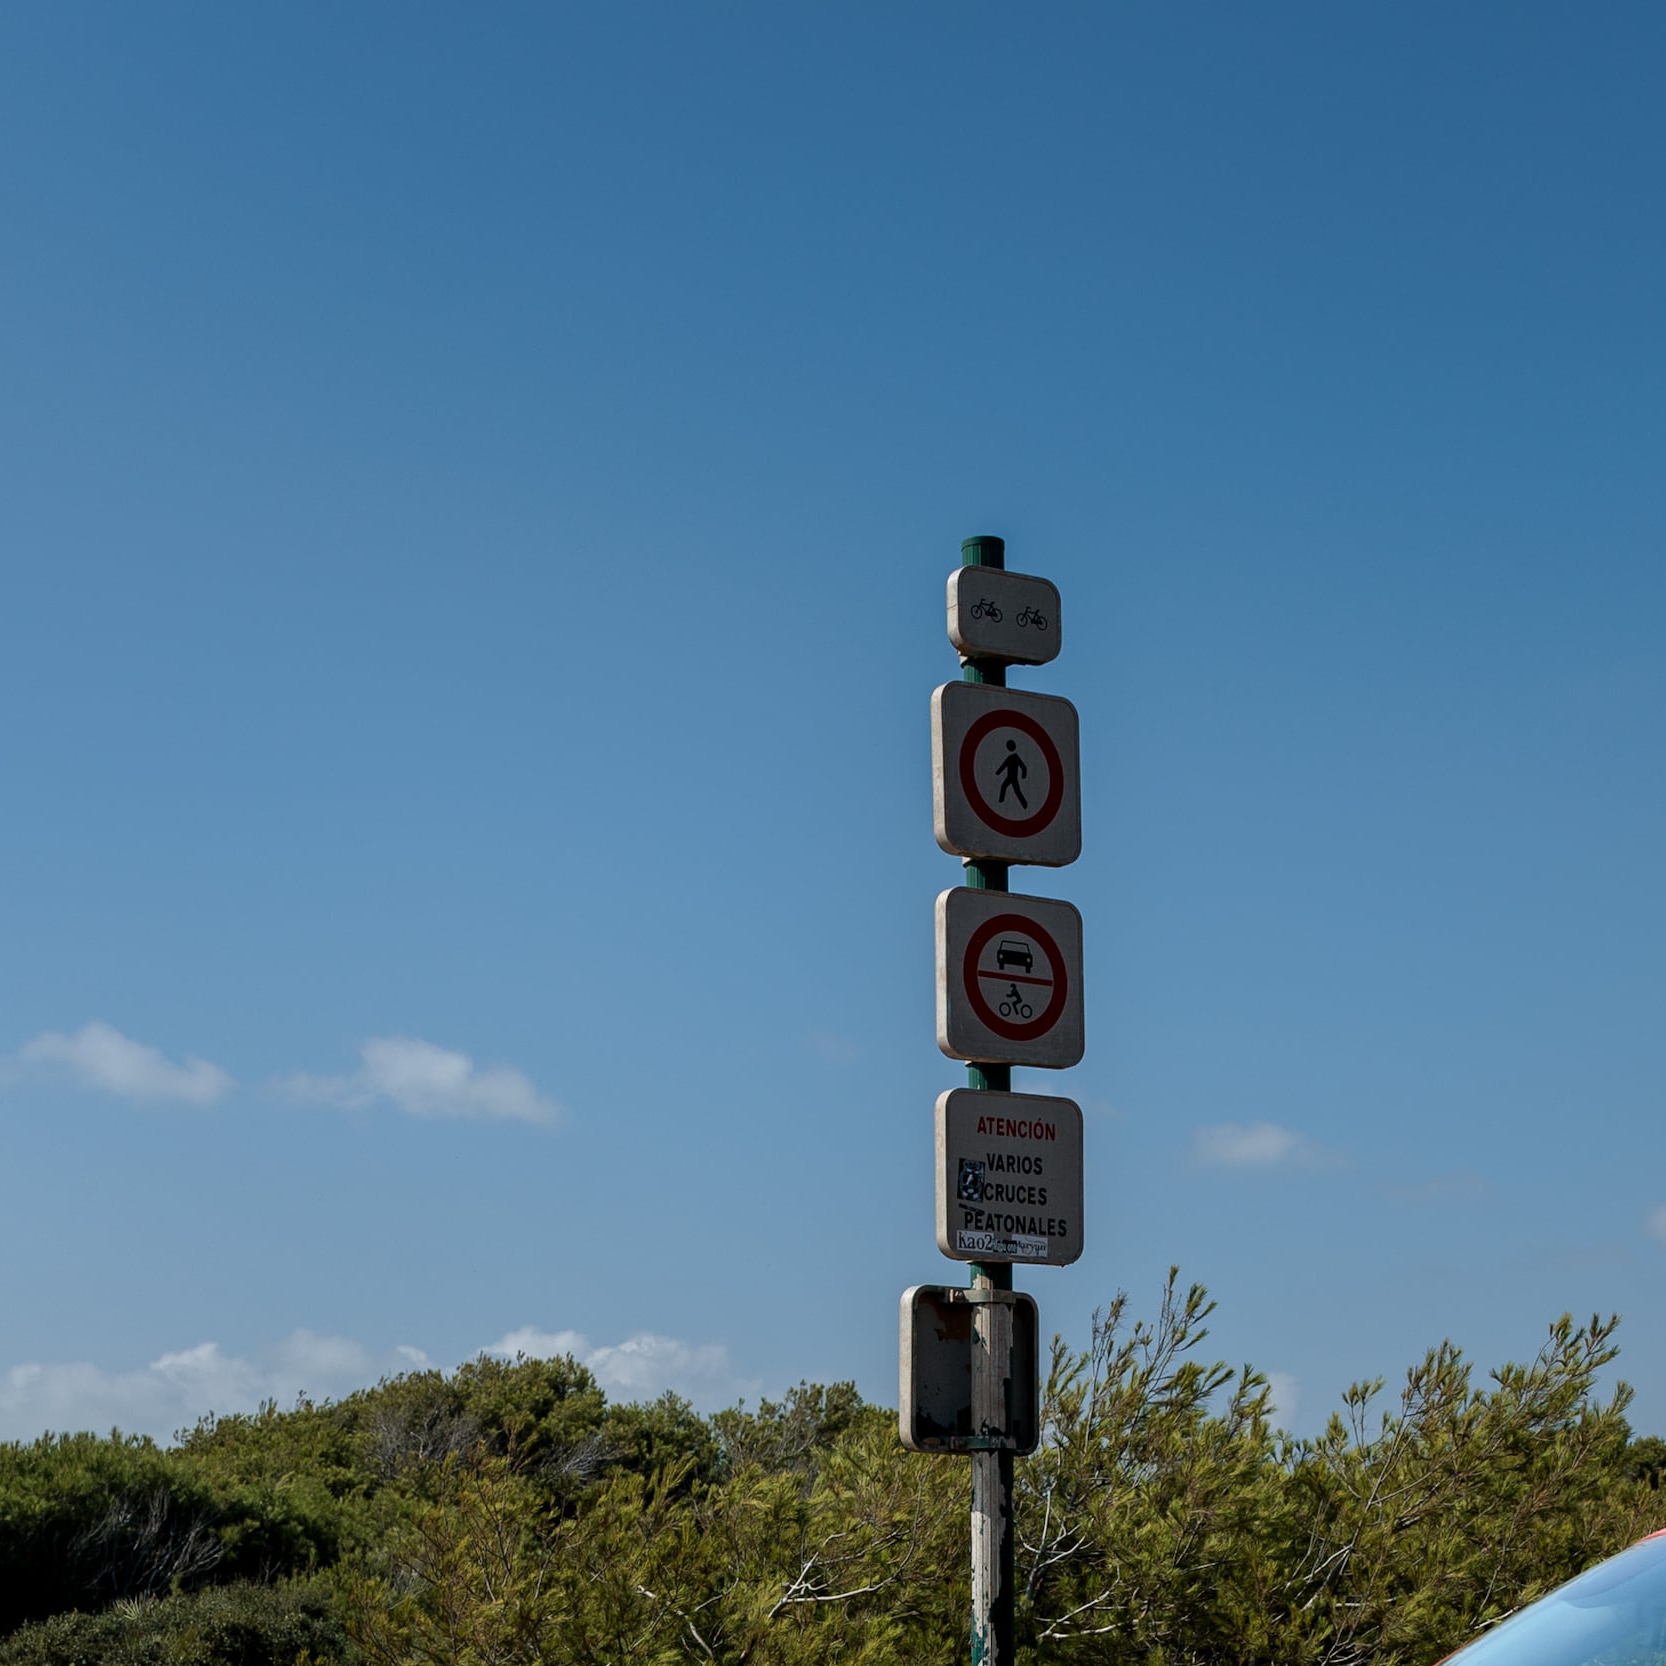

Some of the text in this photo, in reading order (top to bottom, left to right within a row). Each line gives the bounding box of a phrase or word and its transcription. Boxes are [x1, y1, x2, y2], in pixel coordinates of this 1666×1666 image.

[977, 1117, 1056, 1141] ATENCIÓN
[986, 1153, 1043, 1175] VARIOS
[983, 1183, 1048, 1206] CRUCES
[964, 1212, 1068, 1237] PEATONALES
